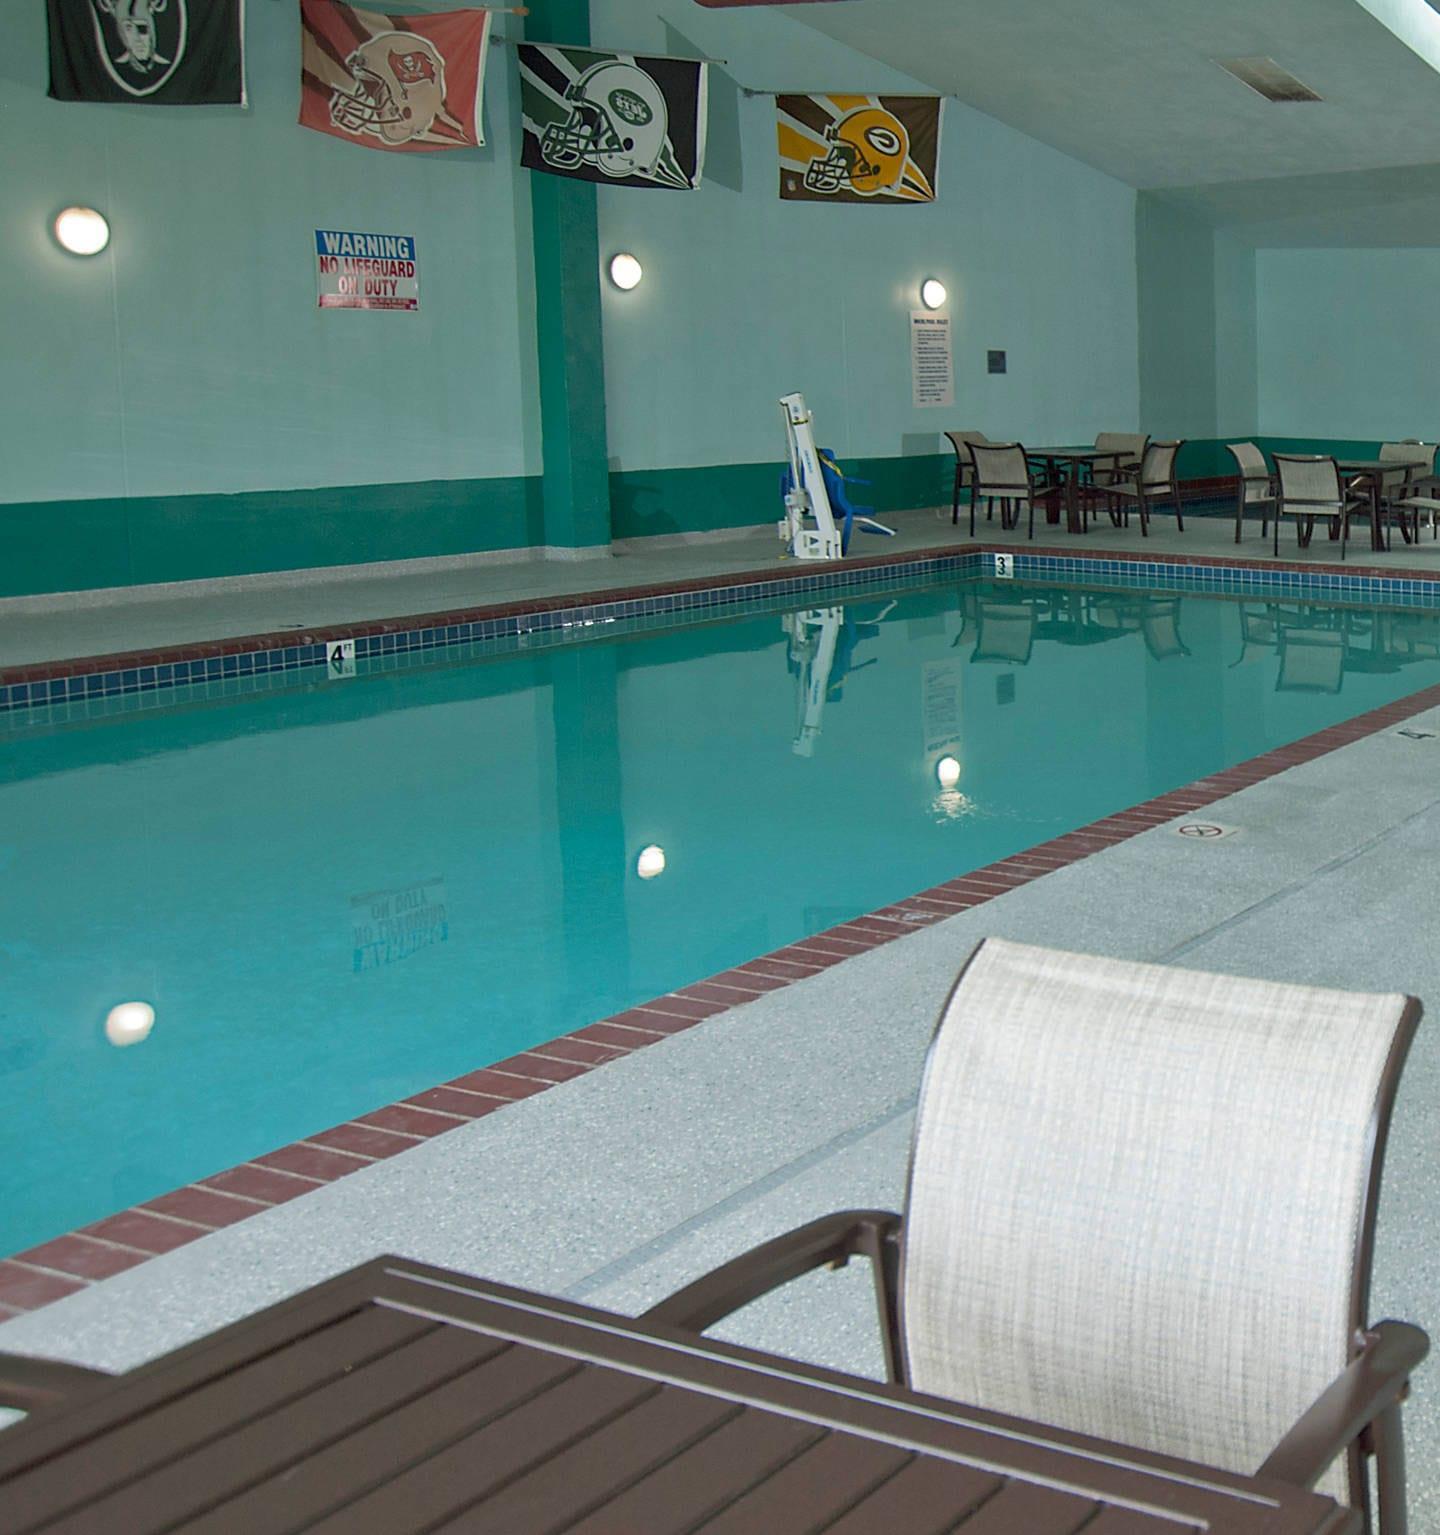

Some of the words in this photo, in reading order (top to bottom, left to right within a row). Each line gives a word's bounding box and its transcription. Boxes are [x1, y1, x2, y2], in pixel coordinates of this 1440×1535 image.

[322, 232, 410, 258] WARNING
[320, 255, 339, 274] NO
[344, 258, 415, 278] LIFEGUARD
[338, 275, 358, 294] ON
[364, 278, 398, 296] DUTY
[997, 556, 1005, 568] 3
[331, 645, 345, 661] 4
